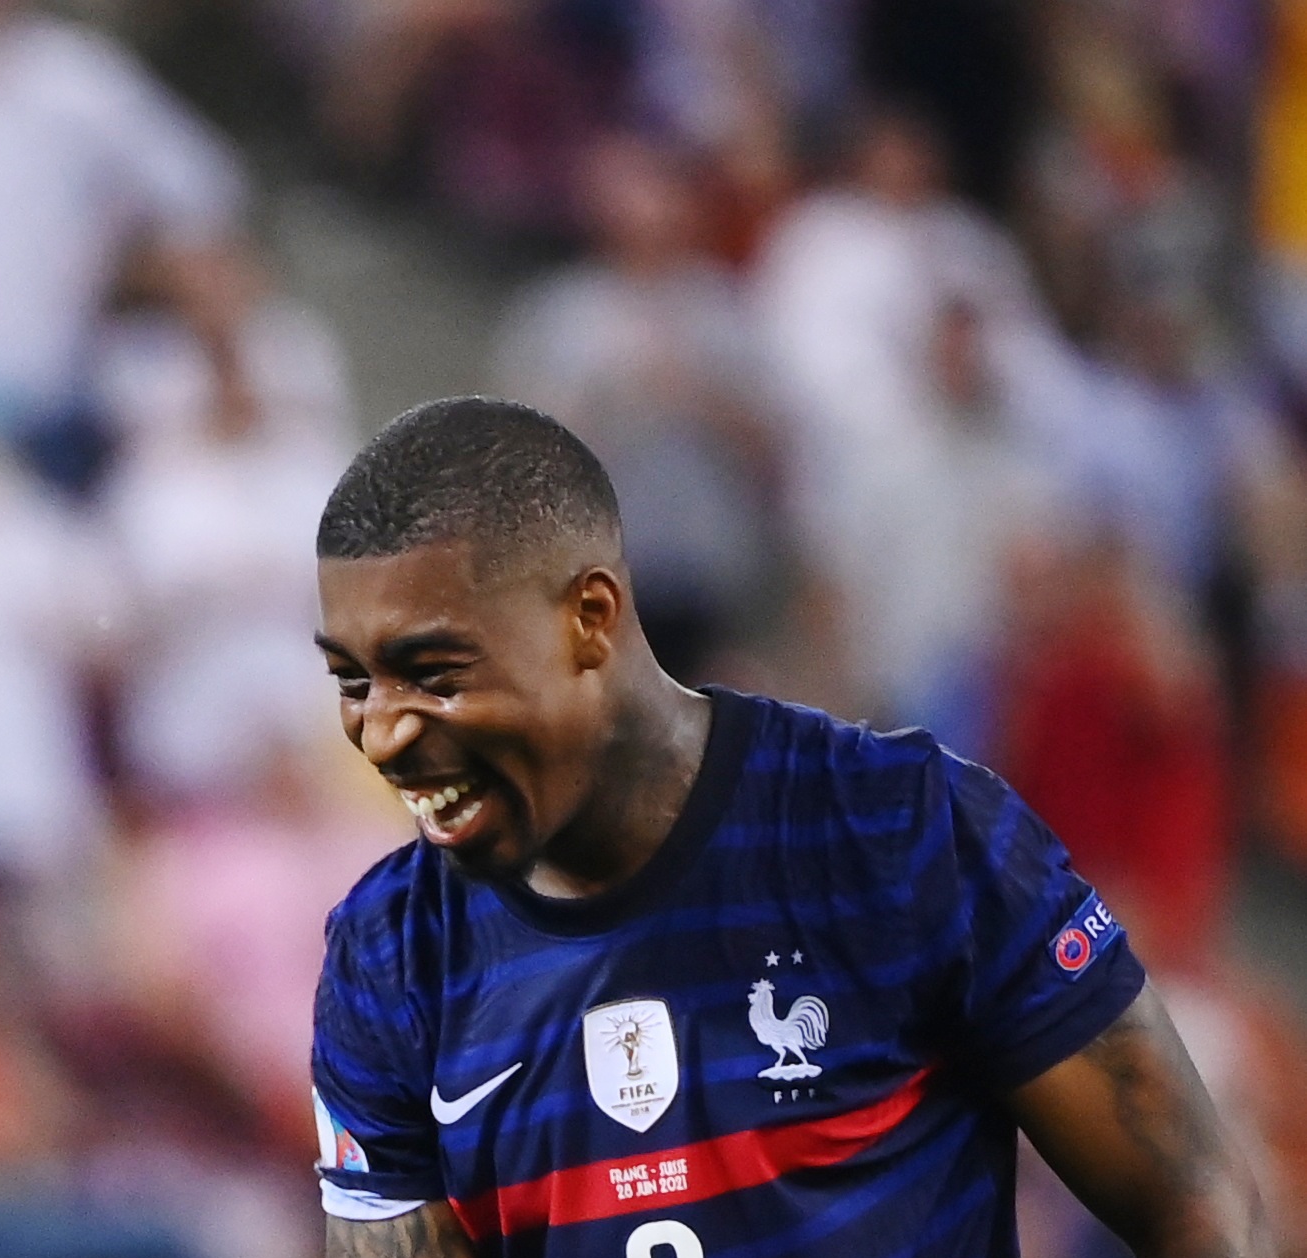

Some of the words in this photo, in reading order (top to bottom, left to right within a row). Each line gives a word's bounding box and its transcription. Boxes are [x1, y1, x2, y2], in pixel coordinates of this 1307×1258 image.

[619, 1084, 655, 1100] FIFA
[609, 1164, 649, 1184] FRANCE
[659, 1158, 688, 1177] SUISSE
[616, 1181, 633, 1200] 28
[635, 1178, 658, 1197] JUIN
[659, 1174, 688, 1193] 2021
